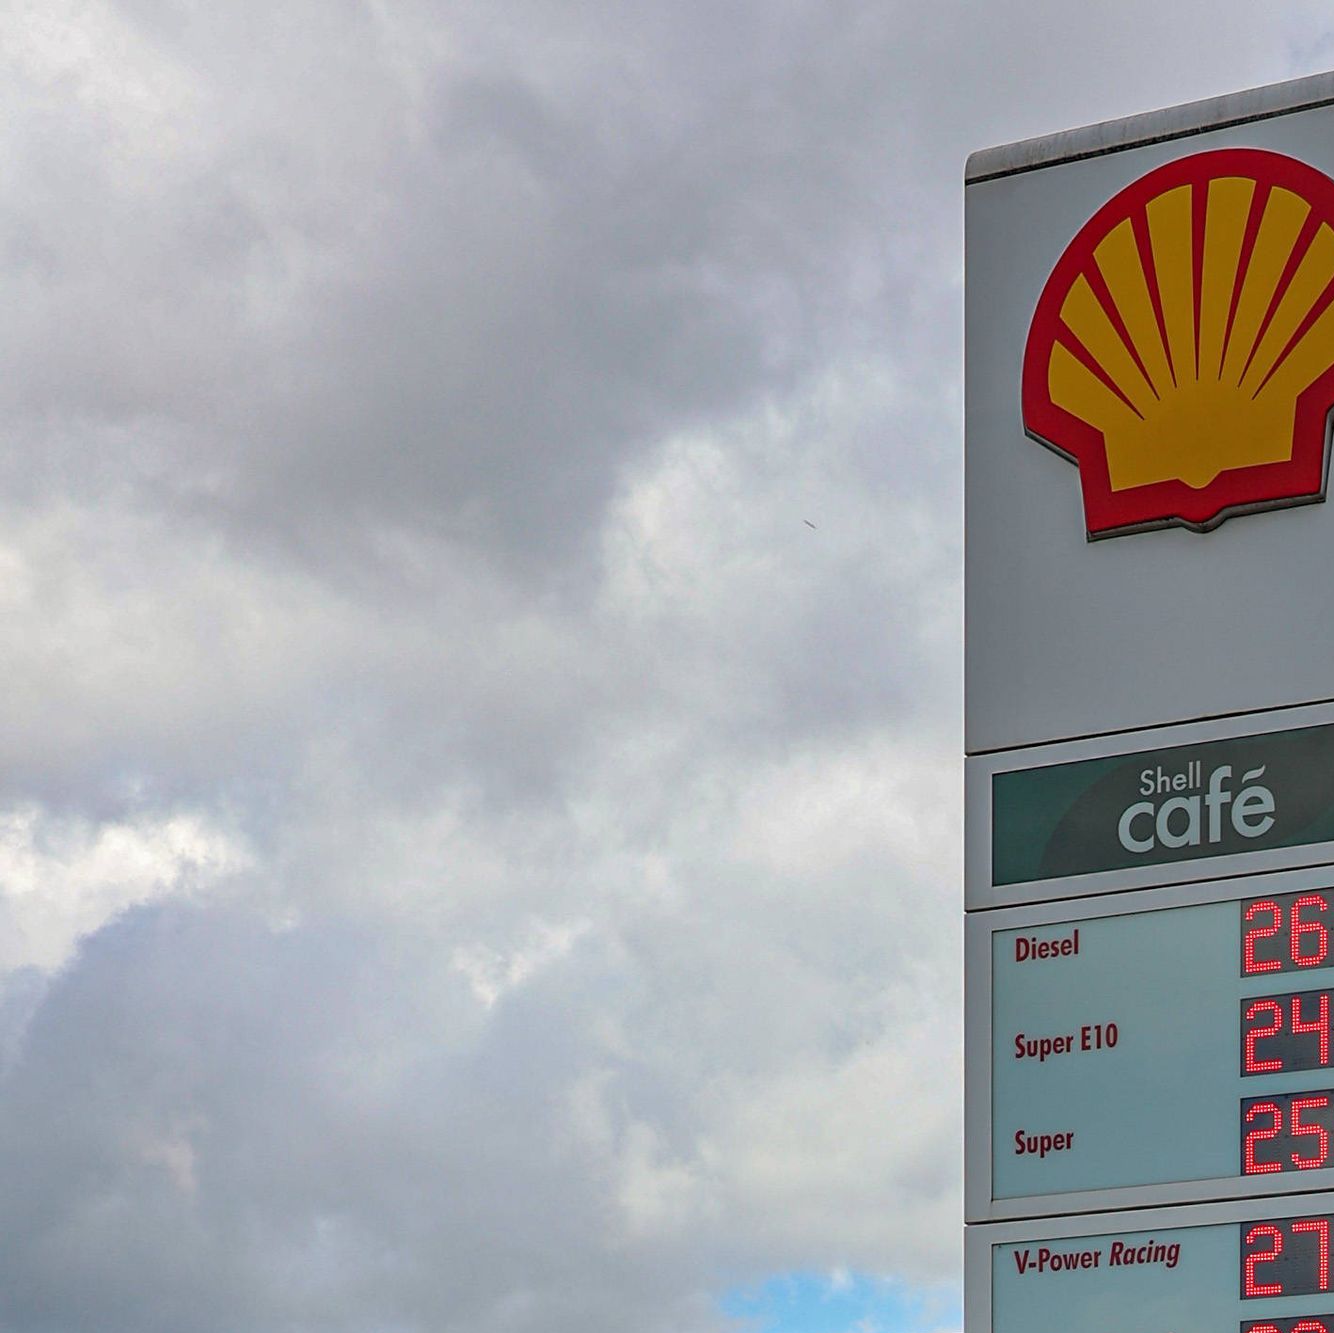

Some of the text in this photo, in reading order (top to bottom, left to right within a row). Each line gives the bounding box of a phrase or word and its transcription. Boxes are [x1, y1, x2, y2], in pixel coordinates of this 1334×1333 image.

[1139, 760, 1200, 796] Shell
[1118, 764, 1276, 853] café
[1015, 930, 1080, 962] Diesel
[1015, 1023, 1118, 1062] Super E10
[1015, 1130, 1074, 1157] Super
[1014, 1241, 1181, 1275] V-Power Racing
